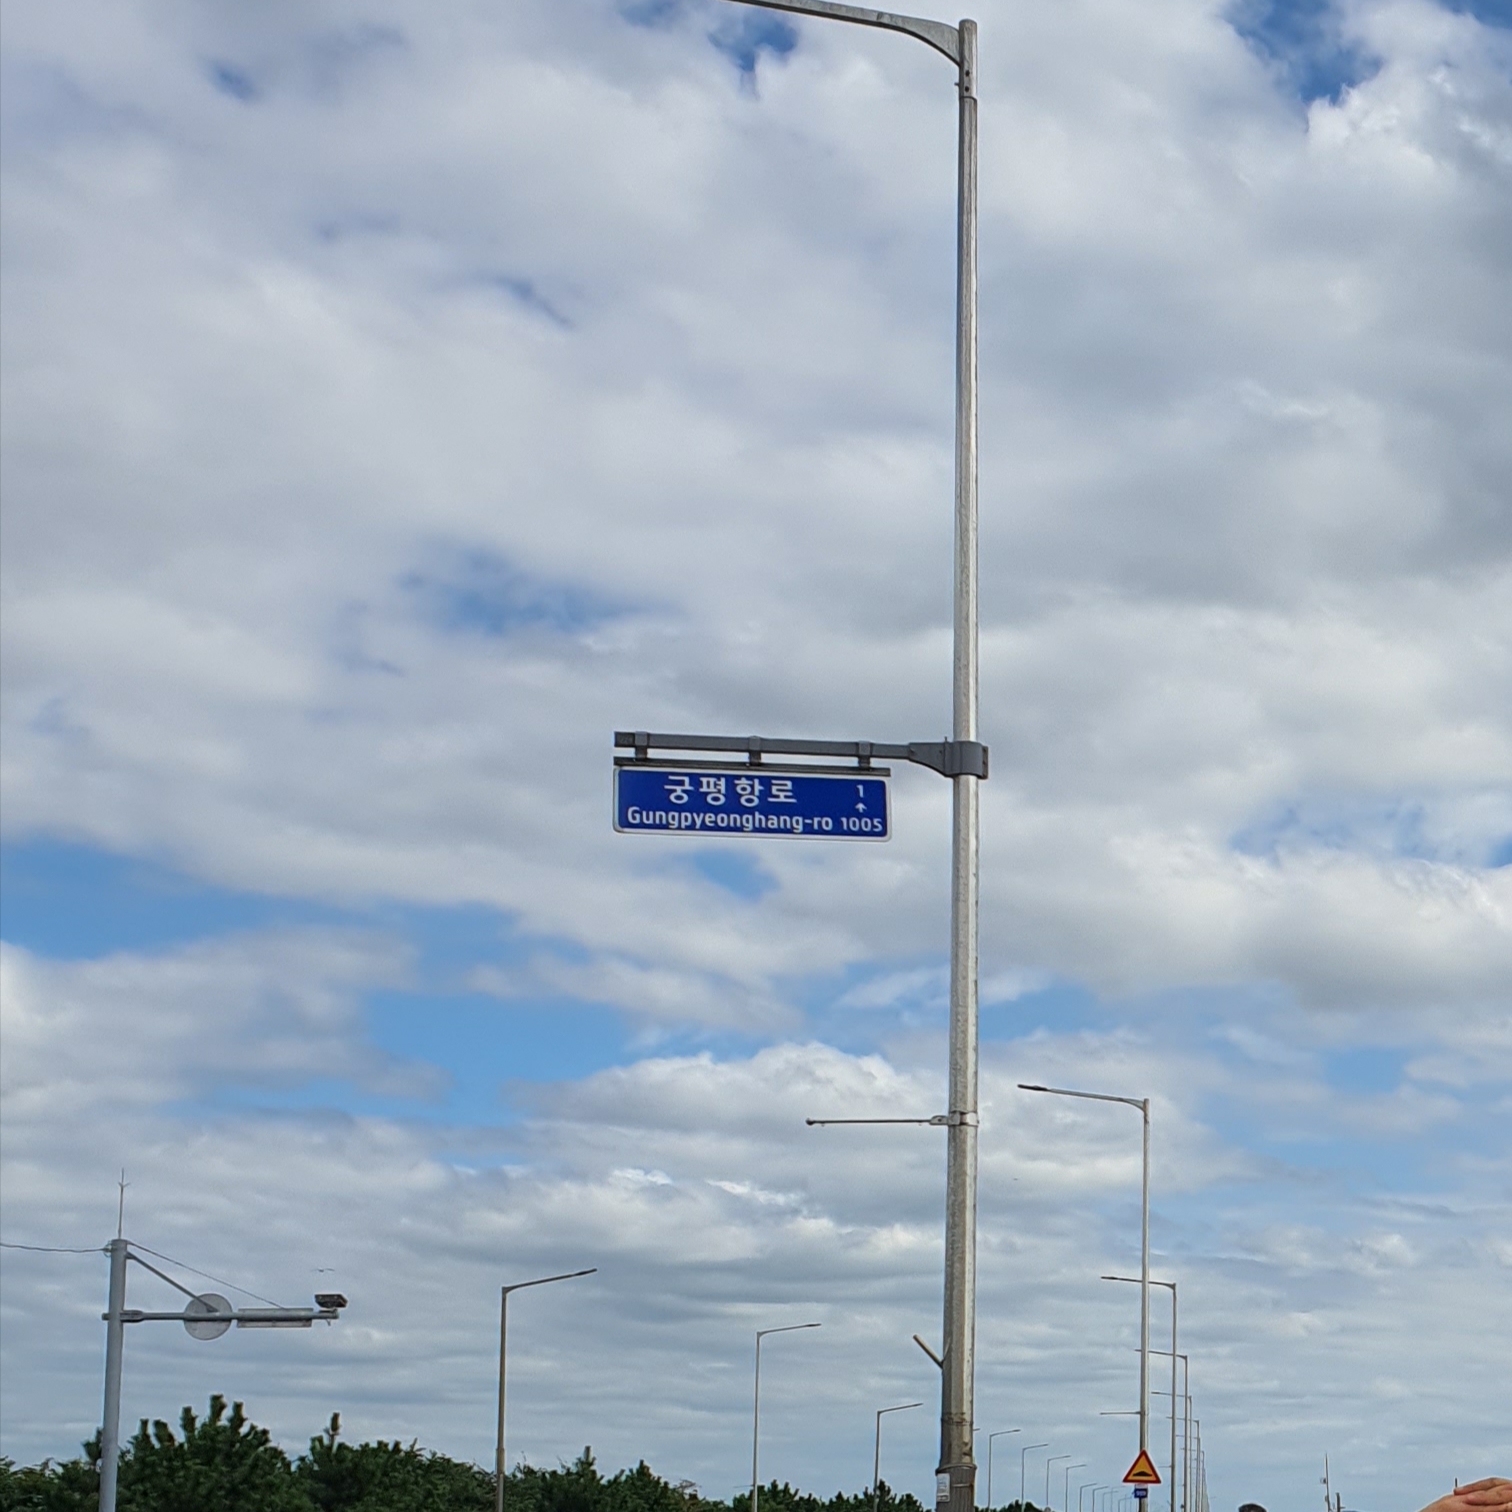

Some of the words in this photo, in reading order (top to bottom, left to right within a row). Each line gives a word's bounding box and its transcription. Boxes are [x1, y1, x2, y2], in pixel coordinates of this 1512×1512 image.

[664, 775, 798, 808] 궁평항로
[856, 784, 864, 798] 1
[627, 806, 833, 833] Gungpyeonghang-ro
[840, 816, 883, 832] 1005
